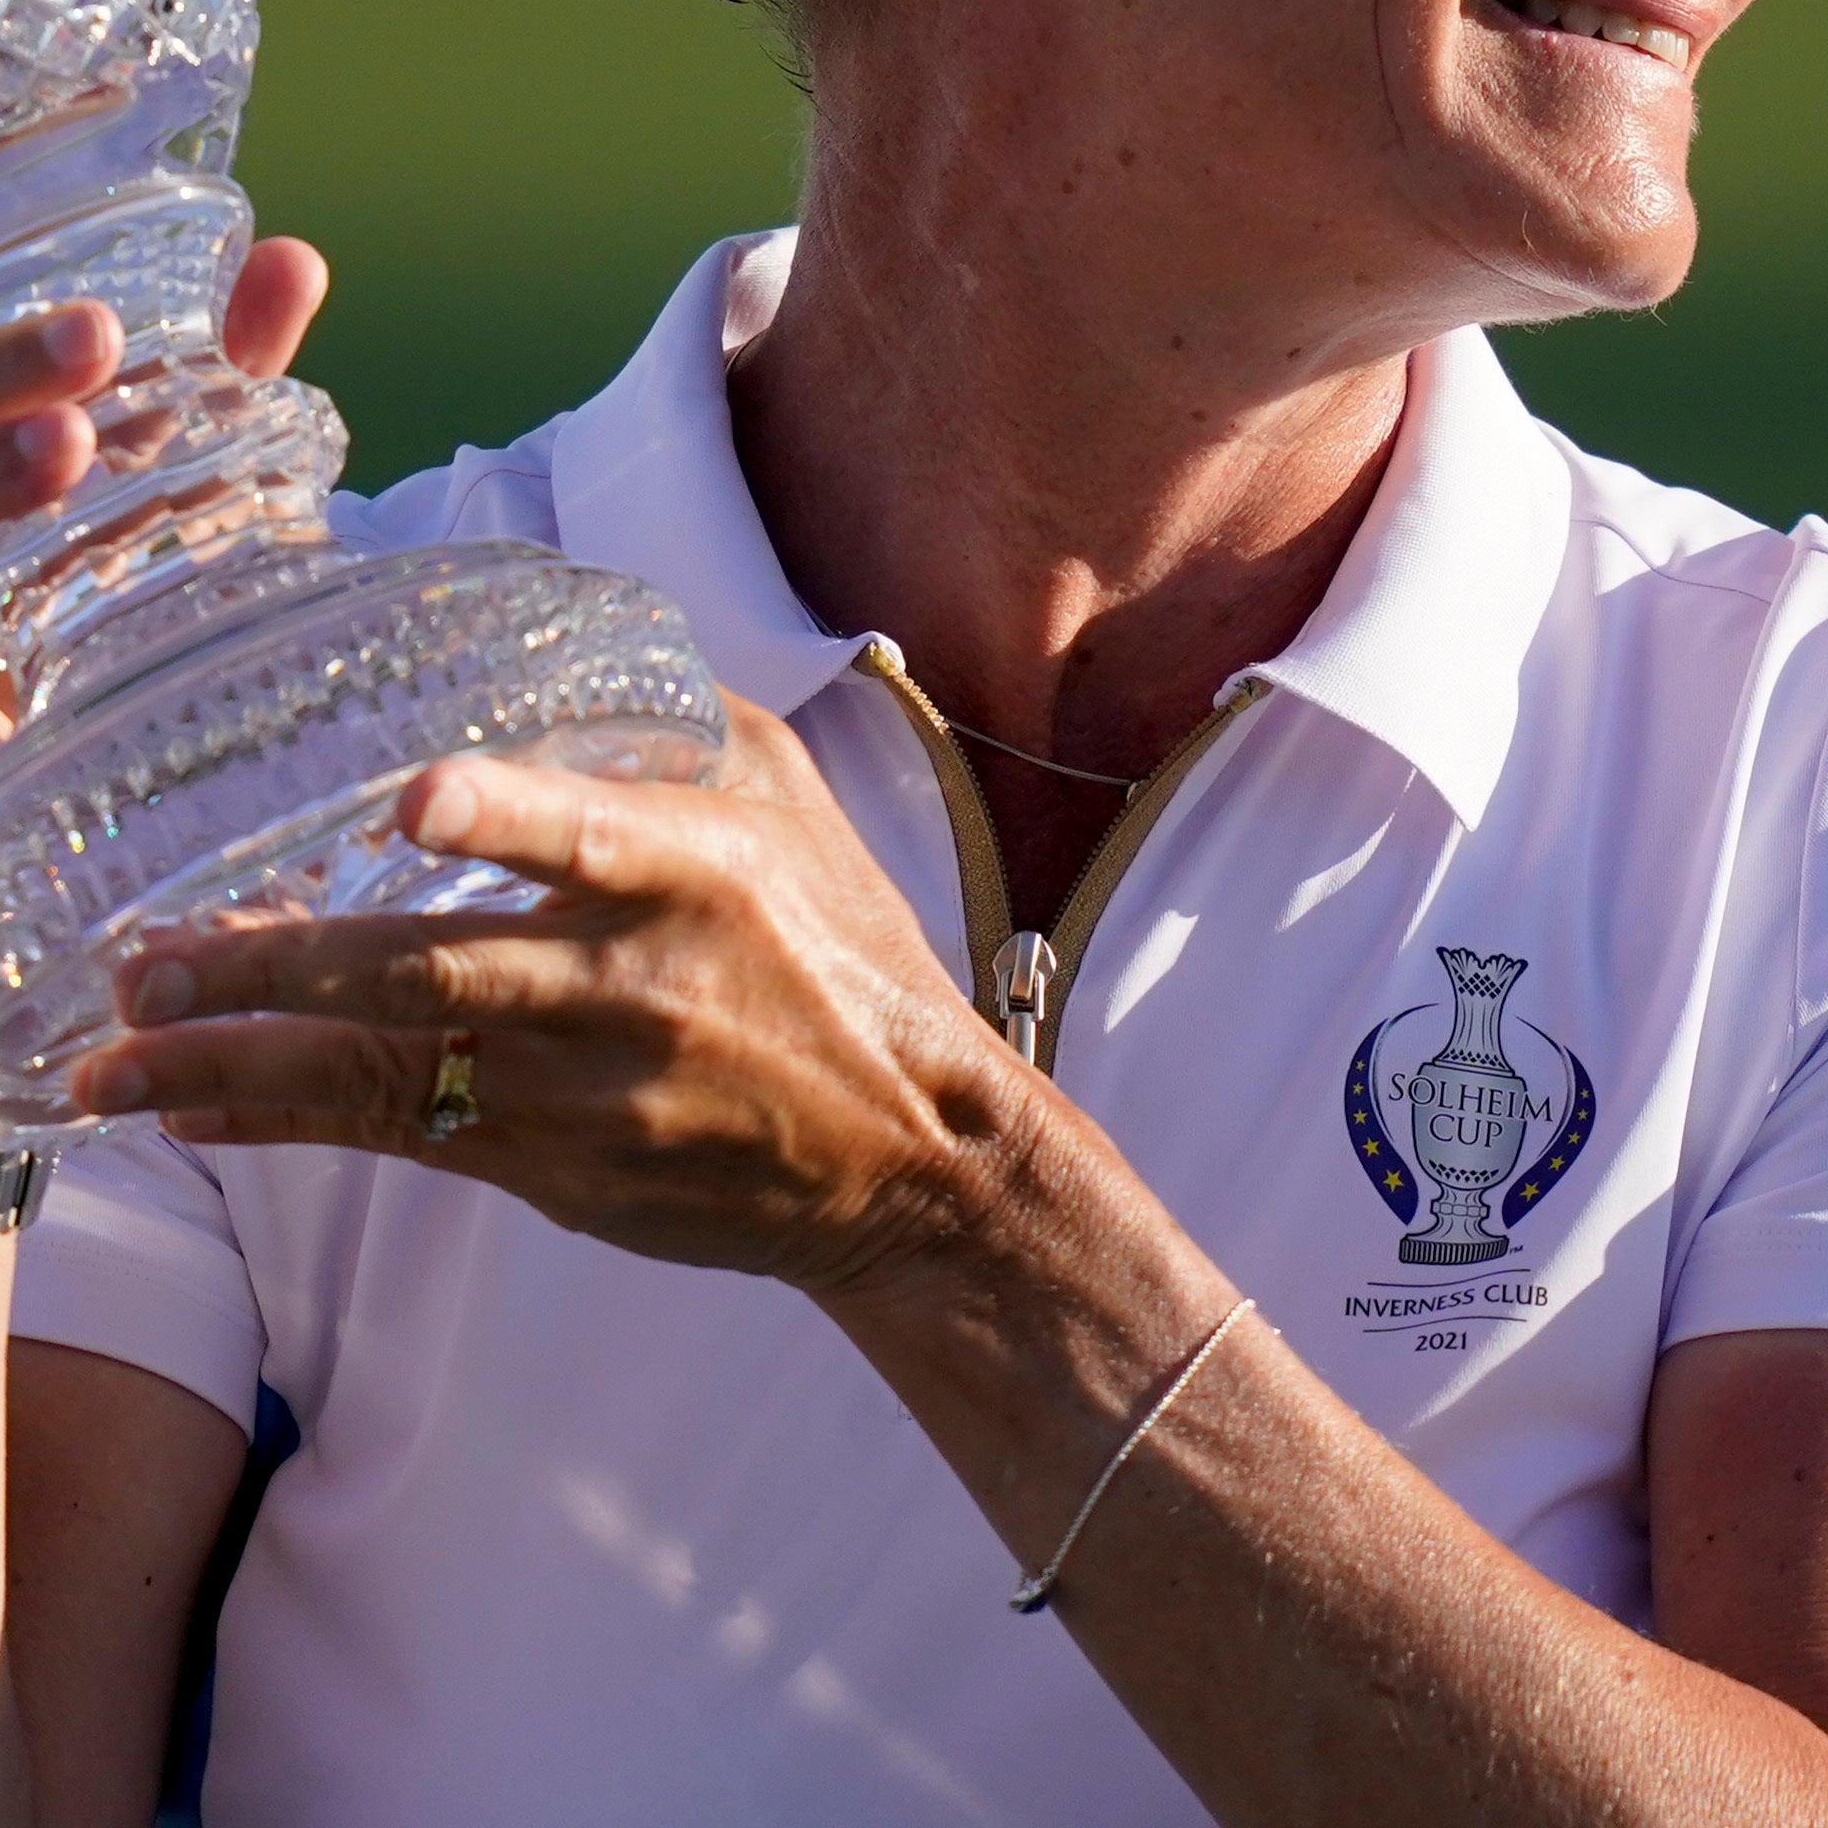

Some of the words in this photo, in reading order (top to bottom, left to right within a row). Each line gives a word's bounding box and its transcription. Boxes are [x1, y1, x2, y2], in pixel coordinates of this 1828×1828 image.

[1388, 1072, 1554, 1122] SOLHEIM
[1429, 1113, 1503, 1148] CUP
[1344, 1288, 1476, 1318] INVERNESS
[1484, 1284, 1549, 1307] CLUB
[1415, 1331, 1467, 1352] 2021
